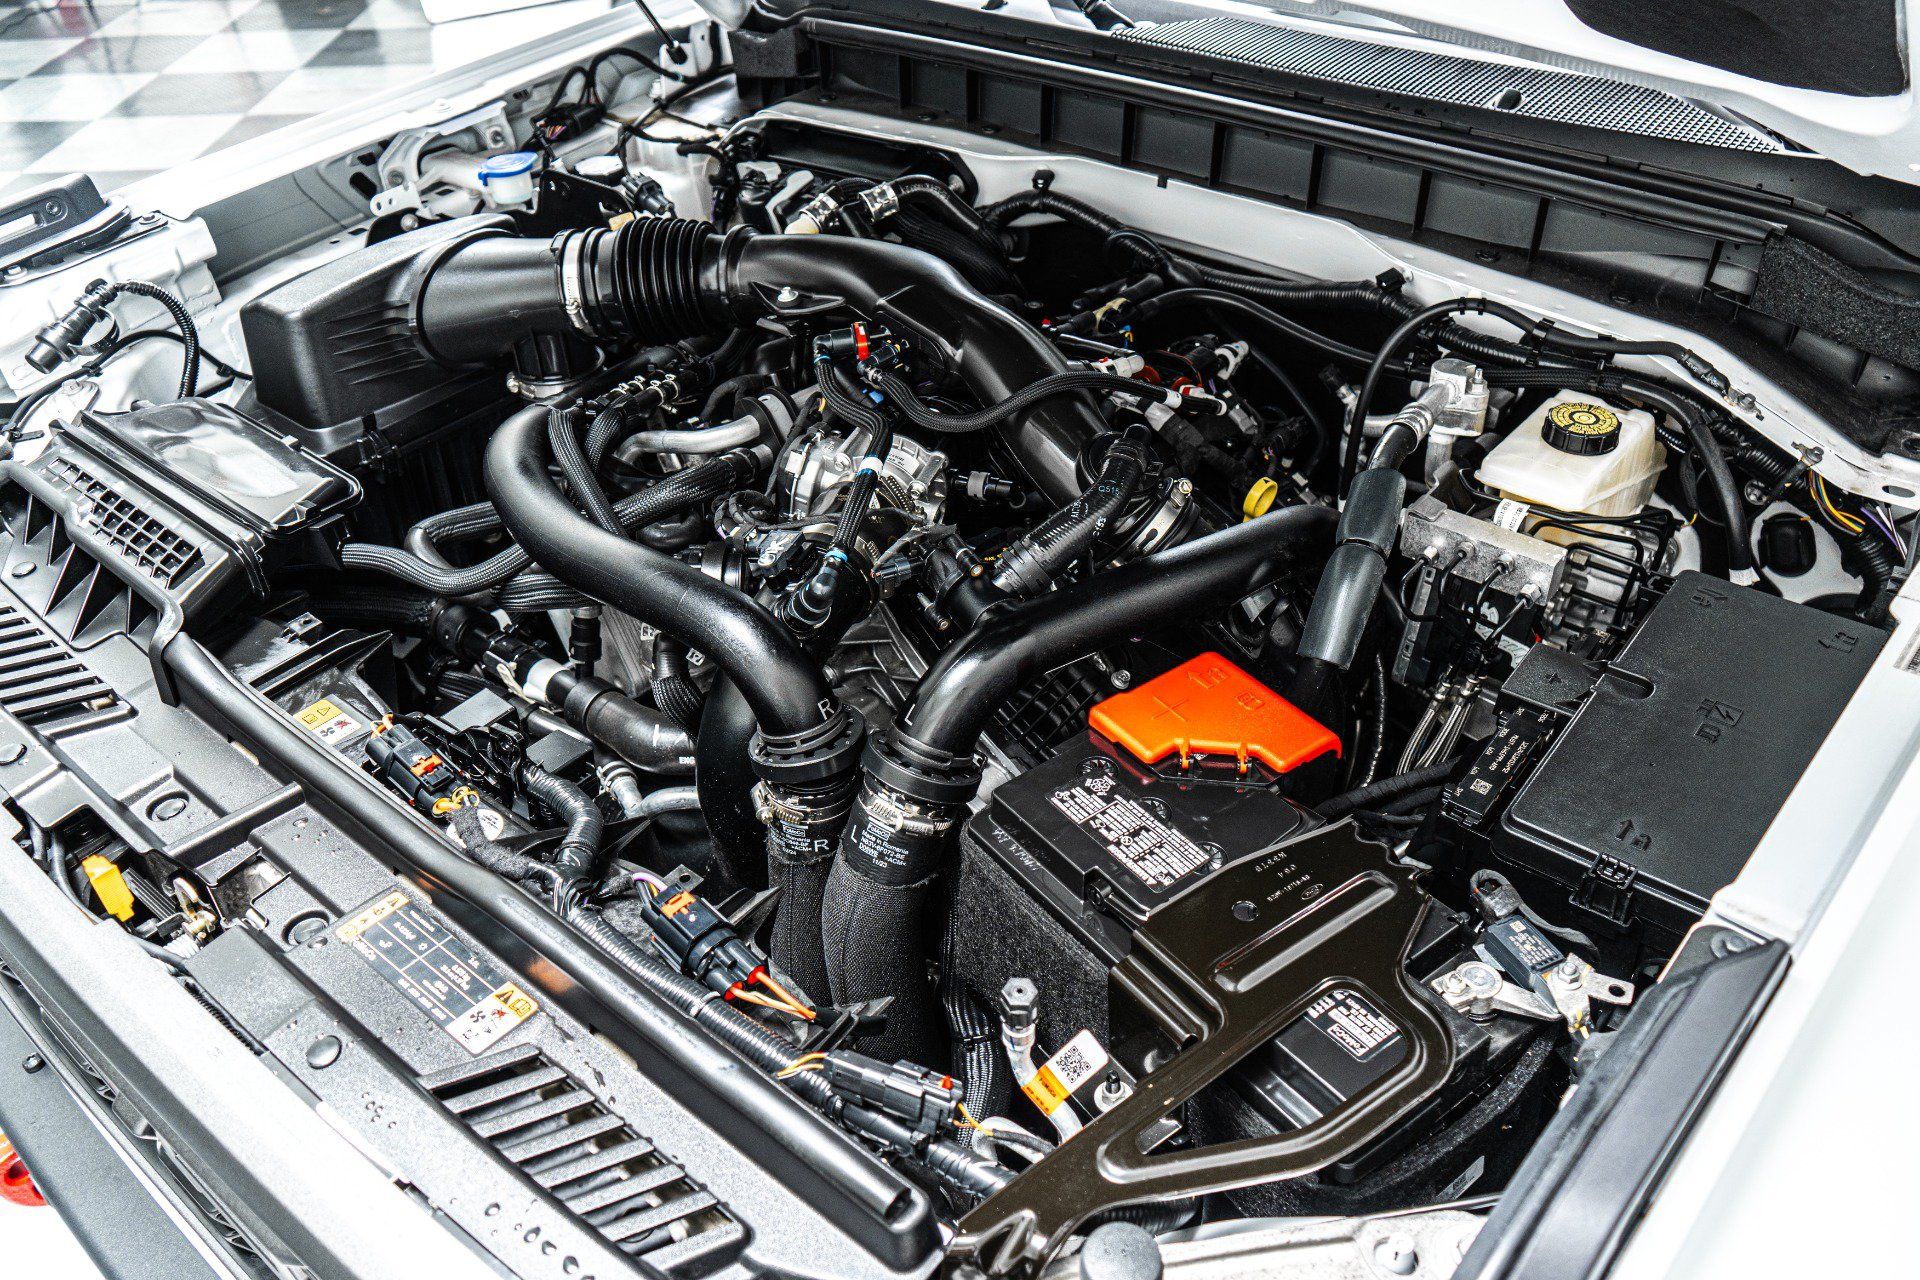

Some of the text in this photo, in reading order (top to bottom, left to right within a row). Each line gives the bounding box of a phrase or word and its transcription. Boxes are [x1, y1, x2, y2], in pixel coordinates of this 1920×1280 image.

[817, 698, 834, 720] R
[904, 703, 916, 726] L
[850, 824, 858, 844] L
[861, 829, 876, 843] Made
[882, 840, 909, 855] Romania
[868, 822, 890, 841] FoMoCo
[814, 839, 829, 852] R
[1330, 1026, 1367, 1054] FoMoCo
